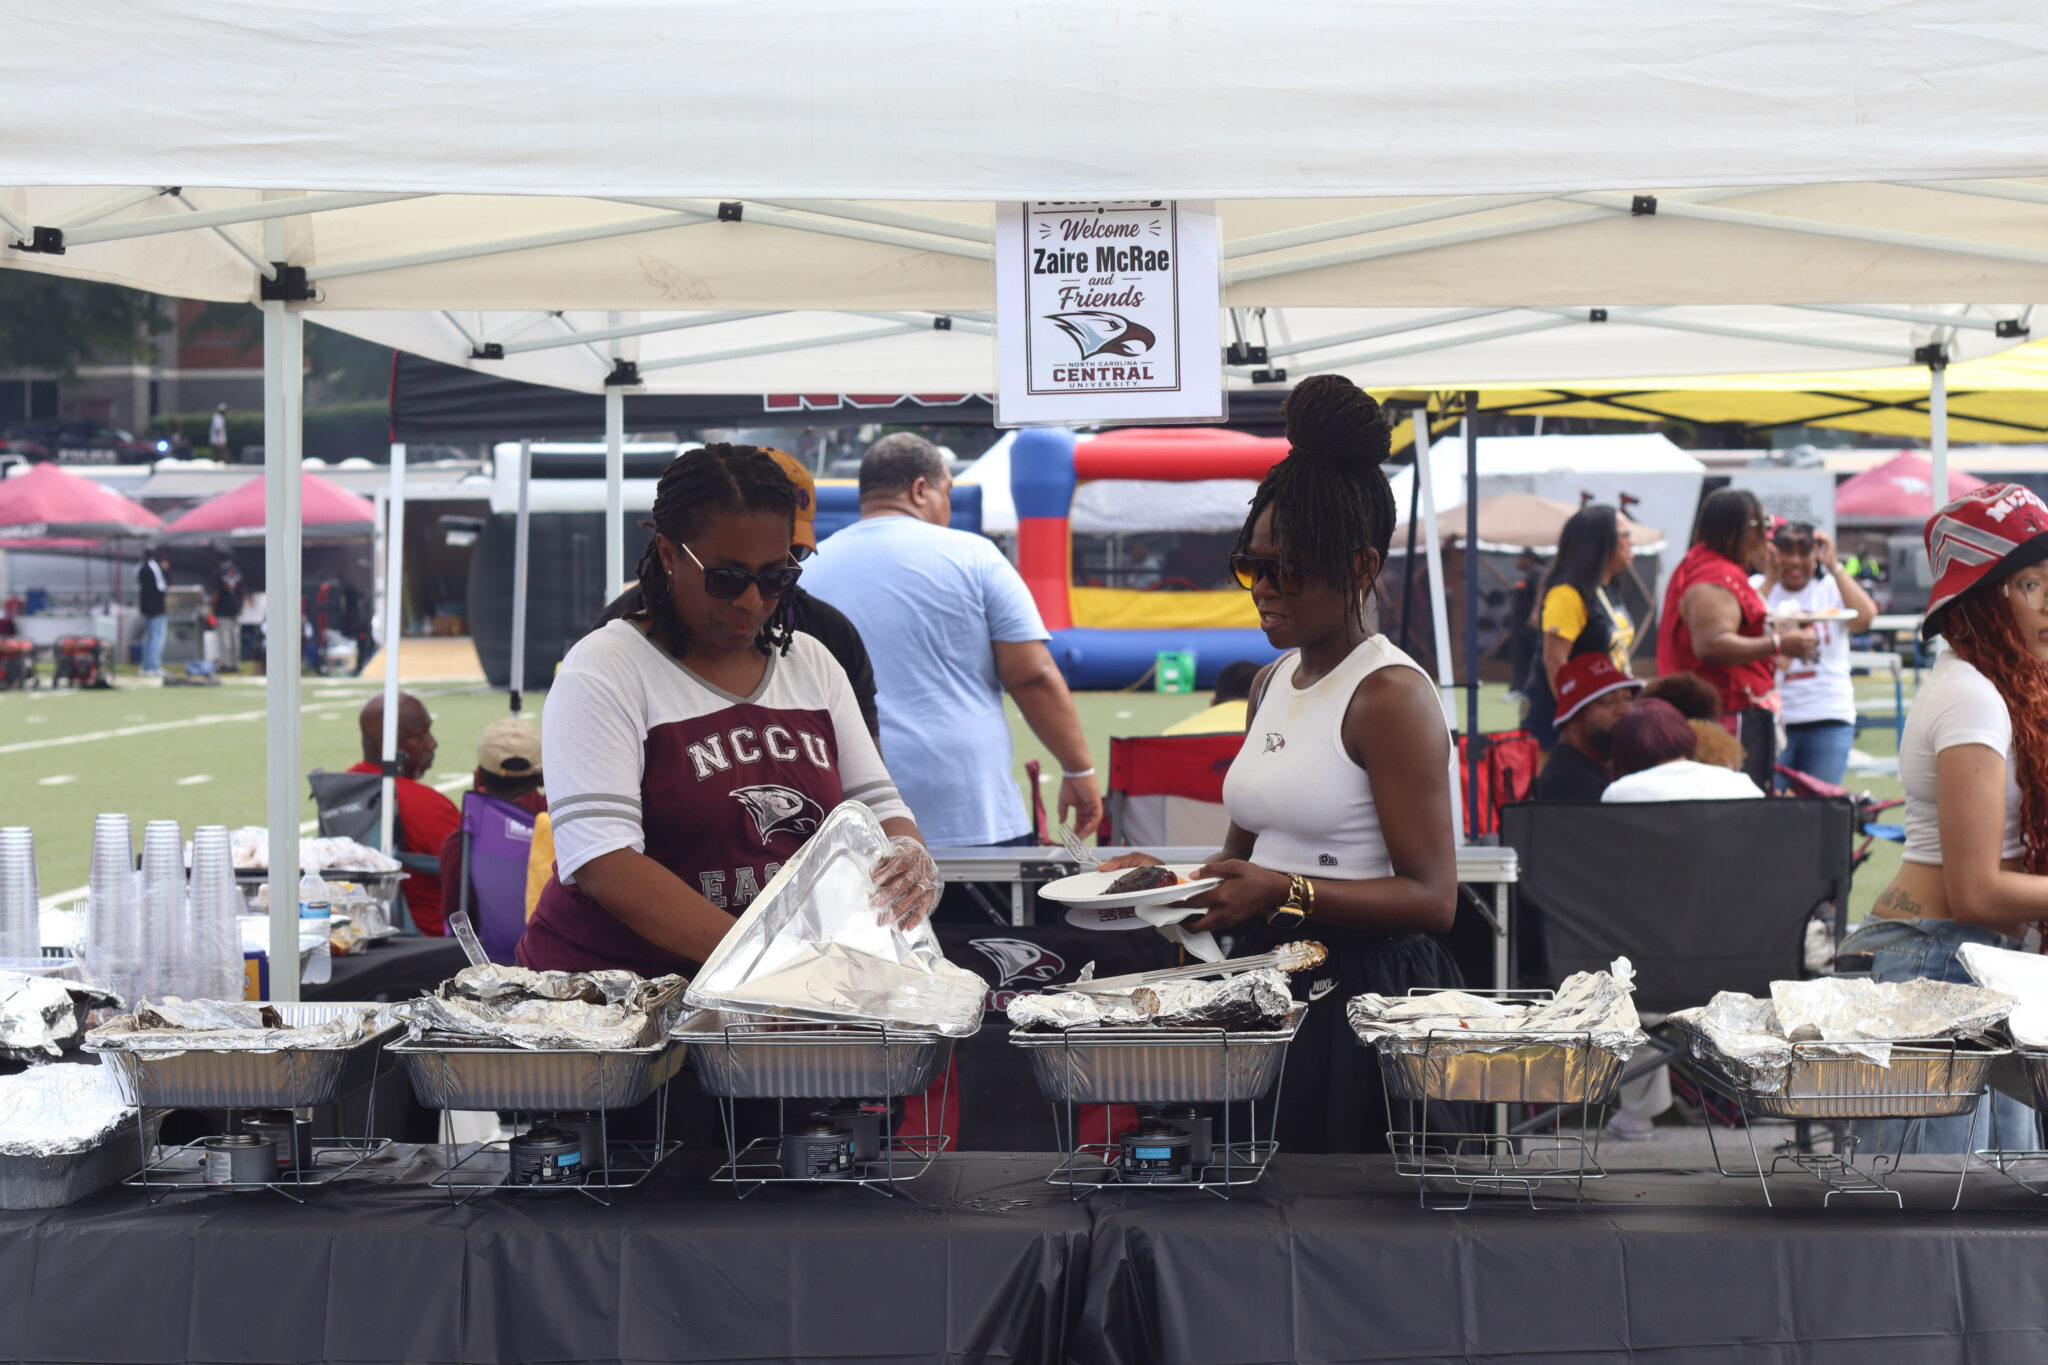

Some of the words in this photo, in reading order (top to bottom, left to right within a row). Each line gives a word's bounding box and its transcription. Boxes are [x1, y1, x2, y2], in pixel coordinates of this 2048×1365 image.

[1059, 217, 1141, 241] Welcome
[1033, 248, 1089, 275] Zaire
[1095, 245, 1170, 273] McRae
[1088, 273, 1115, 286] and
[1058, 285, 1145, 310] Friends
[1053, 366, 1155, 383] CENTRAL
[686, 724, 832, 782] NCCU
[1312, 977, 1333, 992] NIKE
